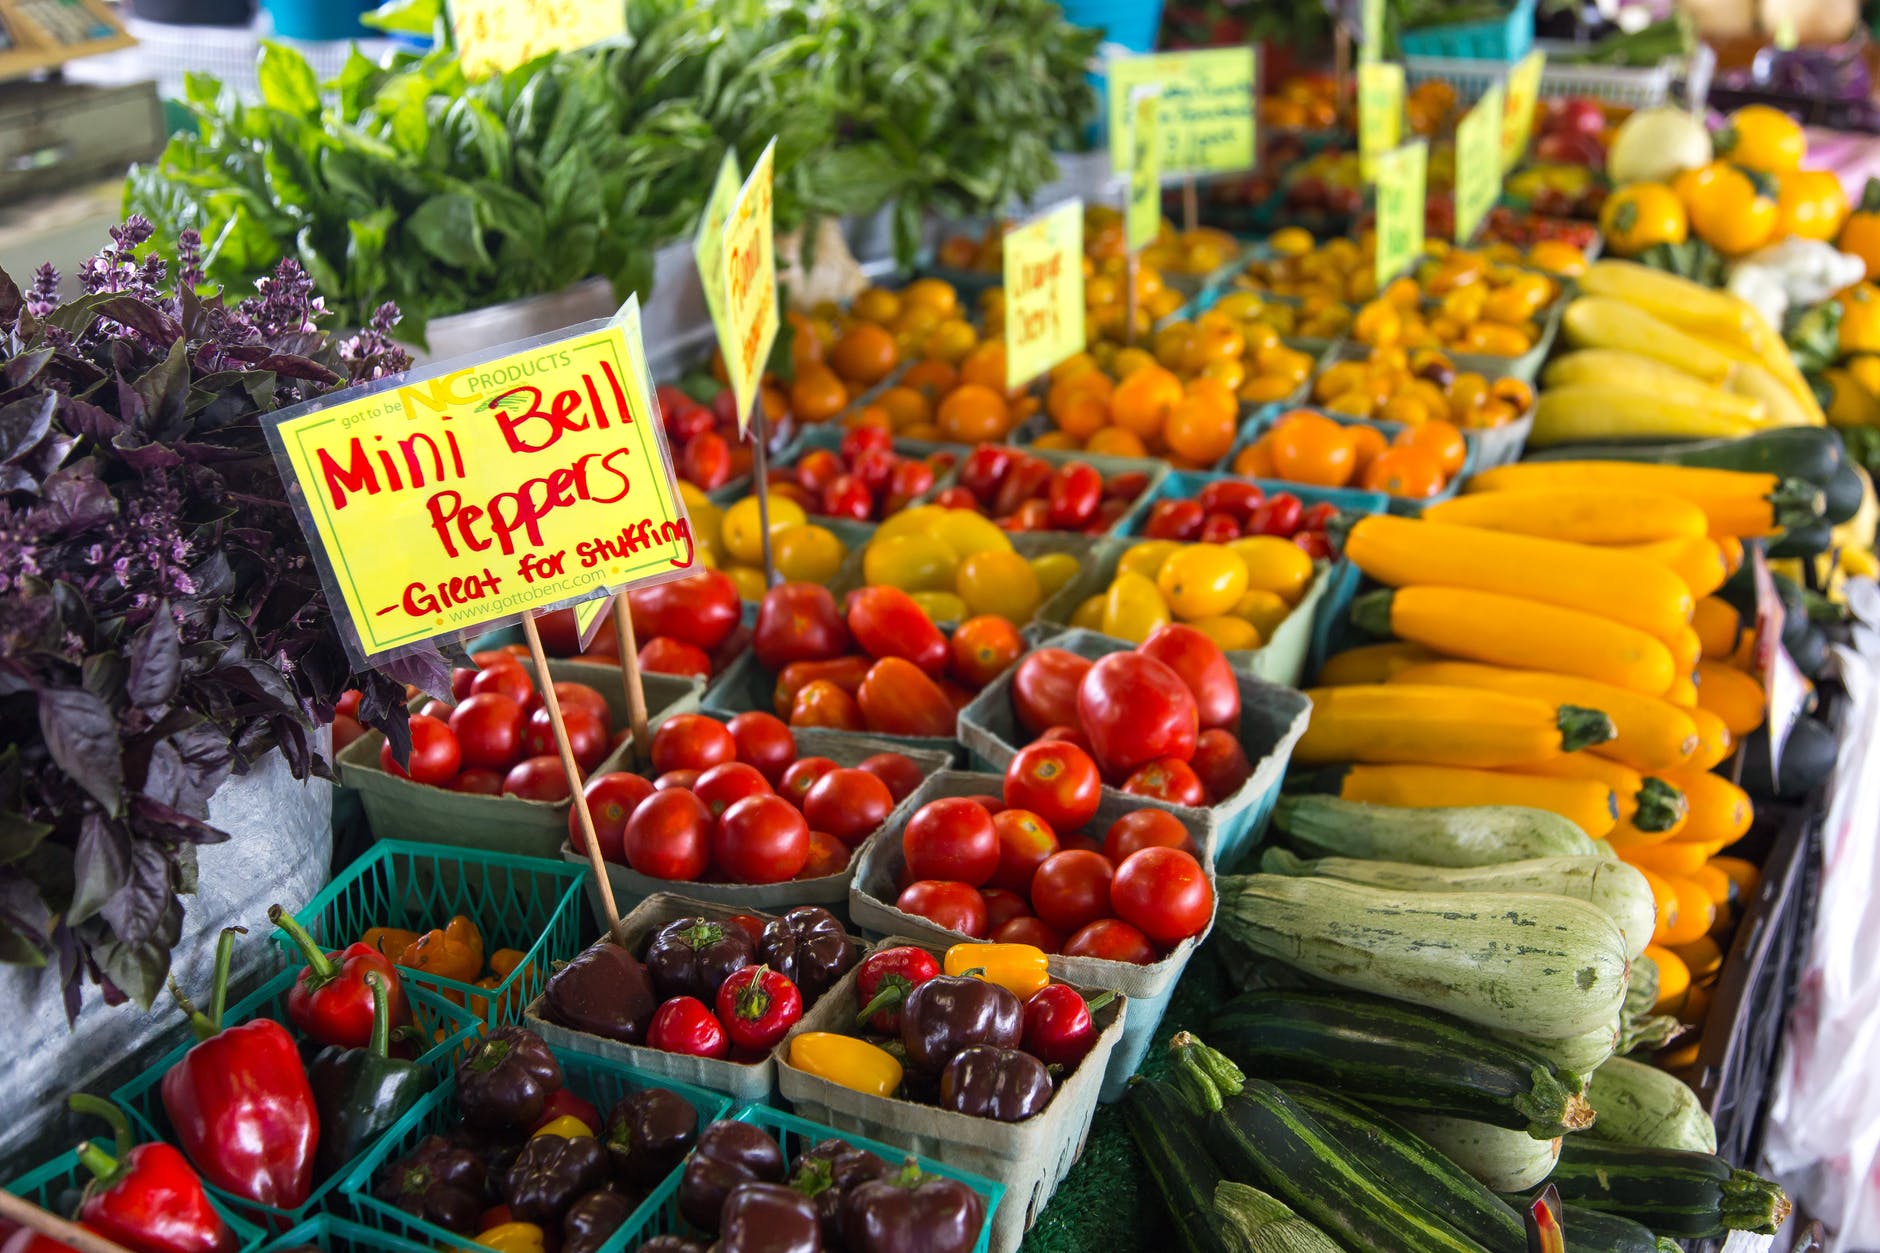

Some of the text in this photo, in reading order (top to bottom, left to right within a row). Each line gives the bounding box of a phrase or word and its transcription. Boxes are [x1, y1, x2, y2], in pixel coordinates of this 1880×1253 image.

[342, 413, 366, 429] got
[367, 408, 381, 420] to
[386, 402, 402, 414] be
[398, 368, 484, 421] NC
[467, 351, 571, 393] PRODUCTS
[317, 361, 633, 510] Mini Bell
[426, 448, 630, 558] Peppers
[449, 566, 607, 624] www.gottobenc.com
[518, 550, 565, 583] for
